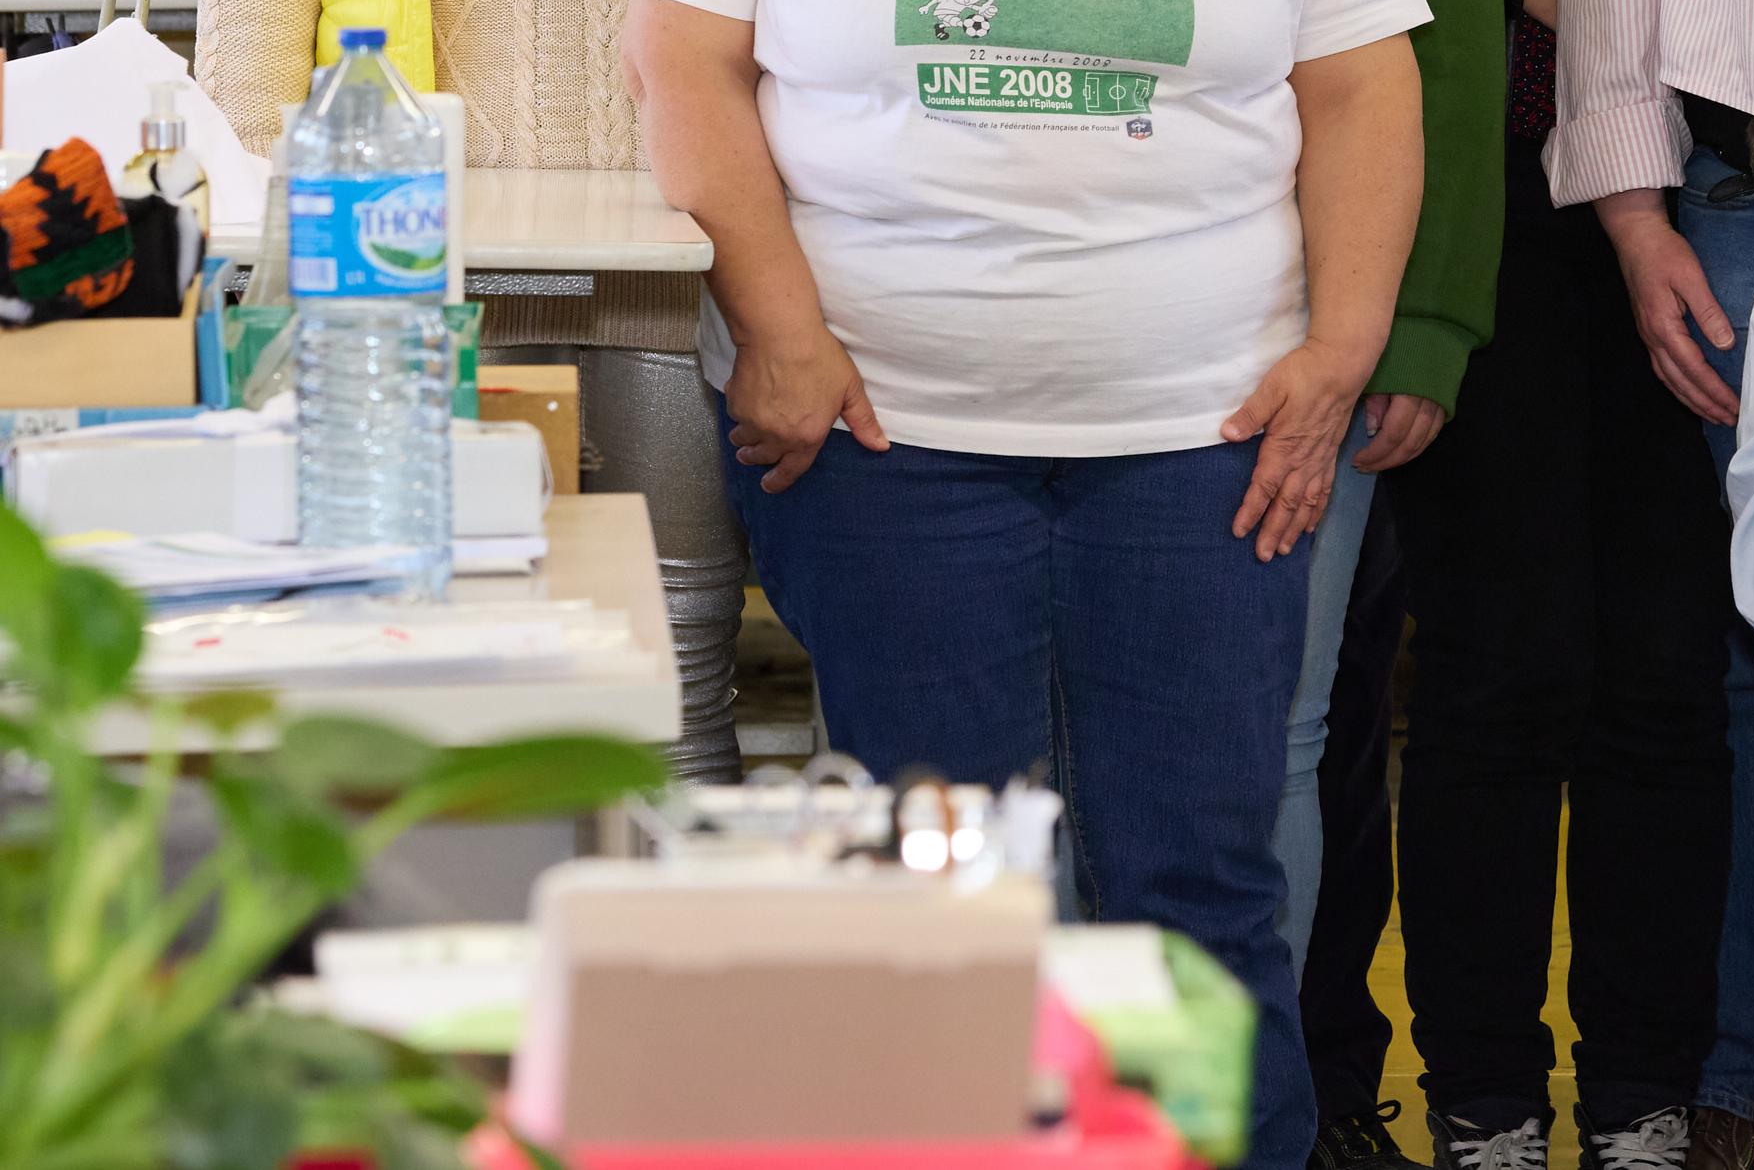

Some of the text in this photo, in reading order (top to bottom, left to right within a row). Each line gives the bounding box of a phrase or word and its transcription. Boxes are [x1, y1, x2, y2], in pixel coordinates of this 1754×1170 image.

[970, 49, 1112, 68] 22 novembre 2008
[923, 66, 1073, 99] JNE 2008
[925, 95, 1073, 111] Journées Nationales de l'Epilepsie
[925, 113, 942, 122] Avec
[951, 118, 977, 128] soutien
[979, 121, 989, 129] de
[1000, 122, 1041, 131] Fédération
[1043, 123, 1079, 132] Française
[1091, 124, 1120, 132] Football
